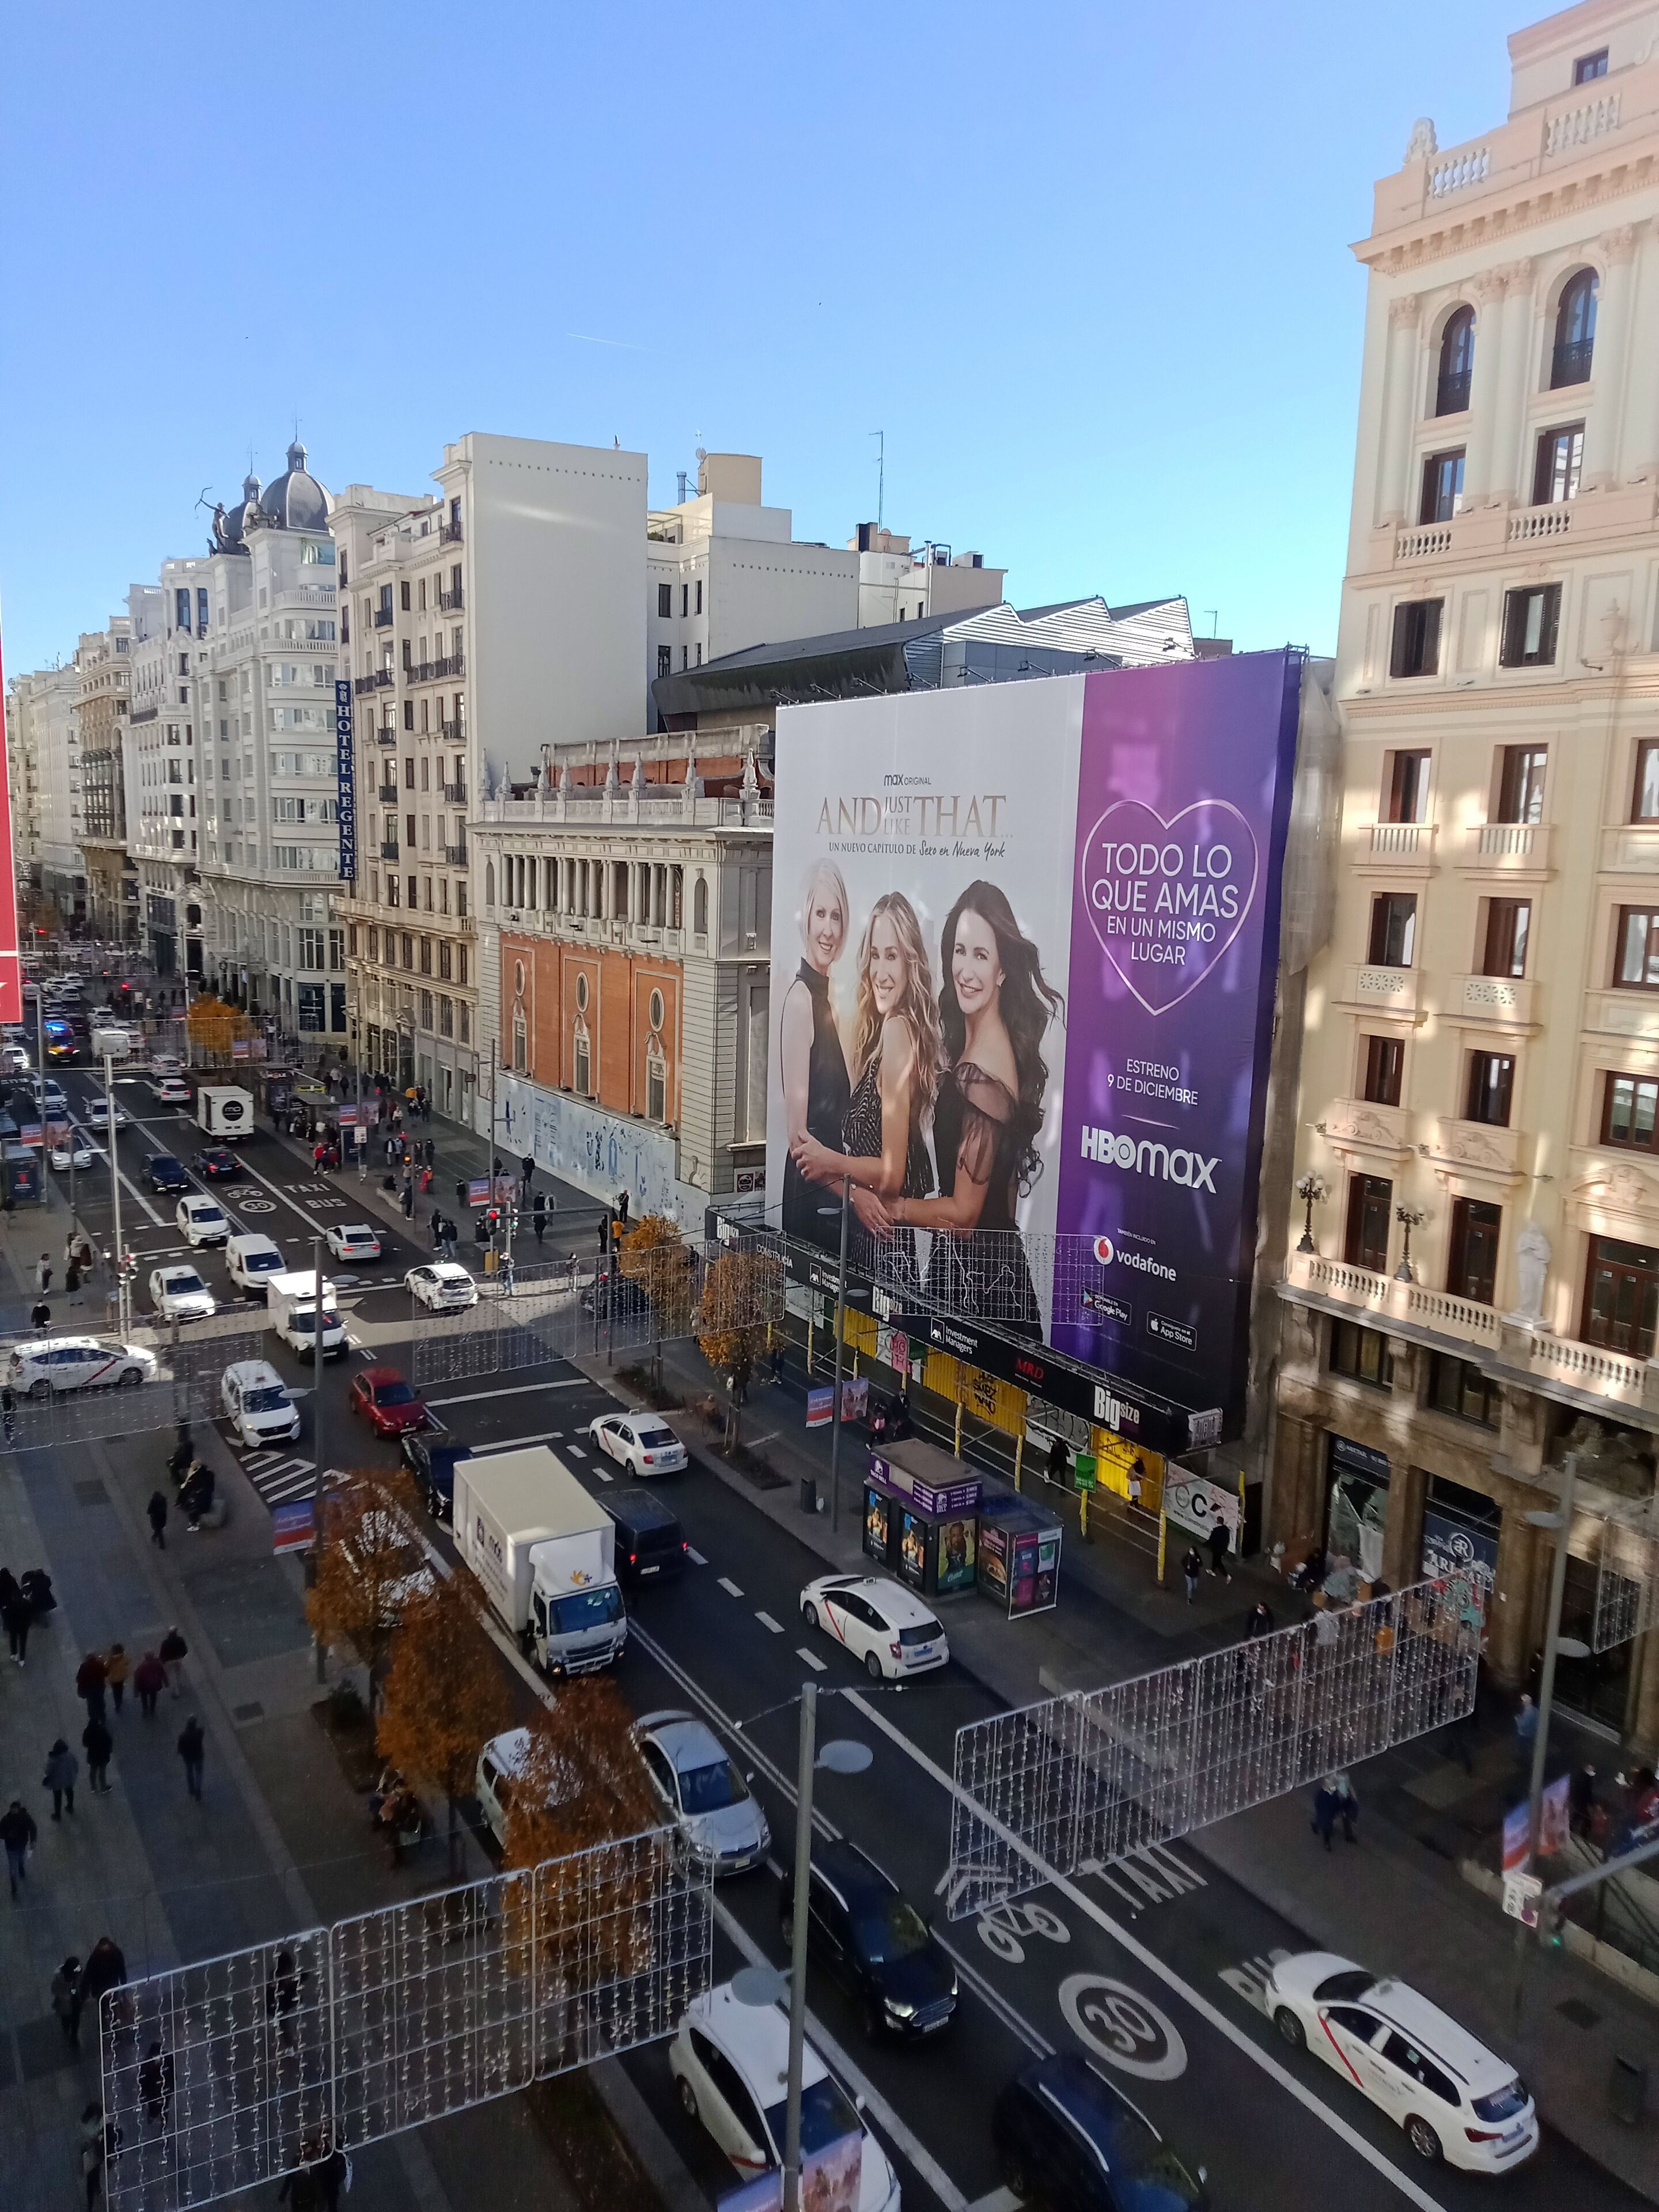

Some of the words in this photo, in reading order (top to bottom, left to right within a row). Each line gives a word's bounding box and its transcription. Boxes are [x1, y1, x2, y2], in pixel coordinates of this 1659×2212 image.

[337, 705, 351, 775] HOTEL
[884, 774, 904, 786] max
[904, 777, 931, 786] ORIGINAL
[816, 797, 882, 835] AND
[884, 796, 912, 813] JUST
[340, 781, 354, 878] REGENTE
[884, 818, 911, 835] LIKE
[829, 842, 839, 852] UN
[841, 842, 866, 853] NUEVO
[868, 842, 904, 854] CAPÍTULO
[906, 844, 916, 854] DE
[919, 840, 937, 857] Sexo
[940, 845, 950, 856] en
[952, 841, 980, 858] Nueva
[984, 842, 1006, 861] York
[1102, 843, 1184, 877] TODO
[1192, 844, 1232, 878] LO
[1092, 878, 1148, 912] QUE
[1154, 882, 1239, 919] AMAS
[1107, 915, 1127, 935] EN
[1131, 917, 1153, 938] UN
[1158, 919, 1216, 943] MISMO
[1131, 941, 1185, 965] LUGAR
[1126, 1058, 1179, 1081] ESTRENO
[1107, 1074, 1115, 1088] 9
[1116, 1075, 1132, 1092] DE
[1134, 1079, 1199, 1105] DICIEMBRE
[283, 1183, 331, 1194] TAXI
[304, 1198, 347, 1209] BUS
[717, 1215, 730, 1246] Big
[1116, 1249, 1177, 1282] vodafone
[872, 1285, 889, 1322] Big
[889, 1296, 903, 1314] size
[1094, 1300, 1115, 1315] Google
[1115, 1308, 1128, 1321] Play
[945, 1325, 978, 1349] Investment
[945, 1336, 972, 1354] Managers
[1160, 1326, 1174, 1339] App
[1175, 1331, 1192, 1345] Store
[1016, 1358, 1044, 1380] MRD
[1094, 1385, 1120, 1431] Big
[1119, 1401, 1139, 1425] size
[870, 1469, 879, 1479] TACO
[878, 1474, 887, 1484] BELL
[1076, 1839, 1209, 1911] TAXI
[1085, 1995, 1157, 2054] 30
